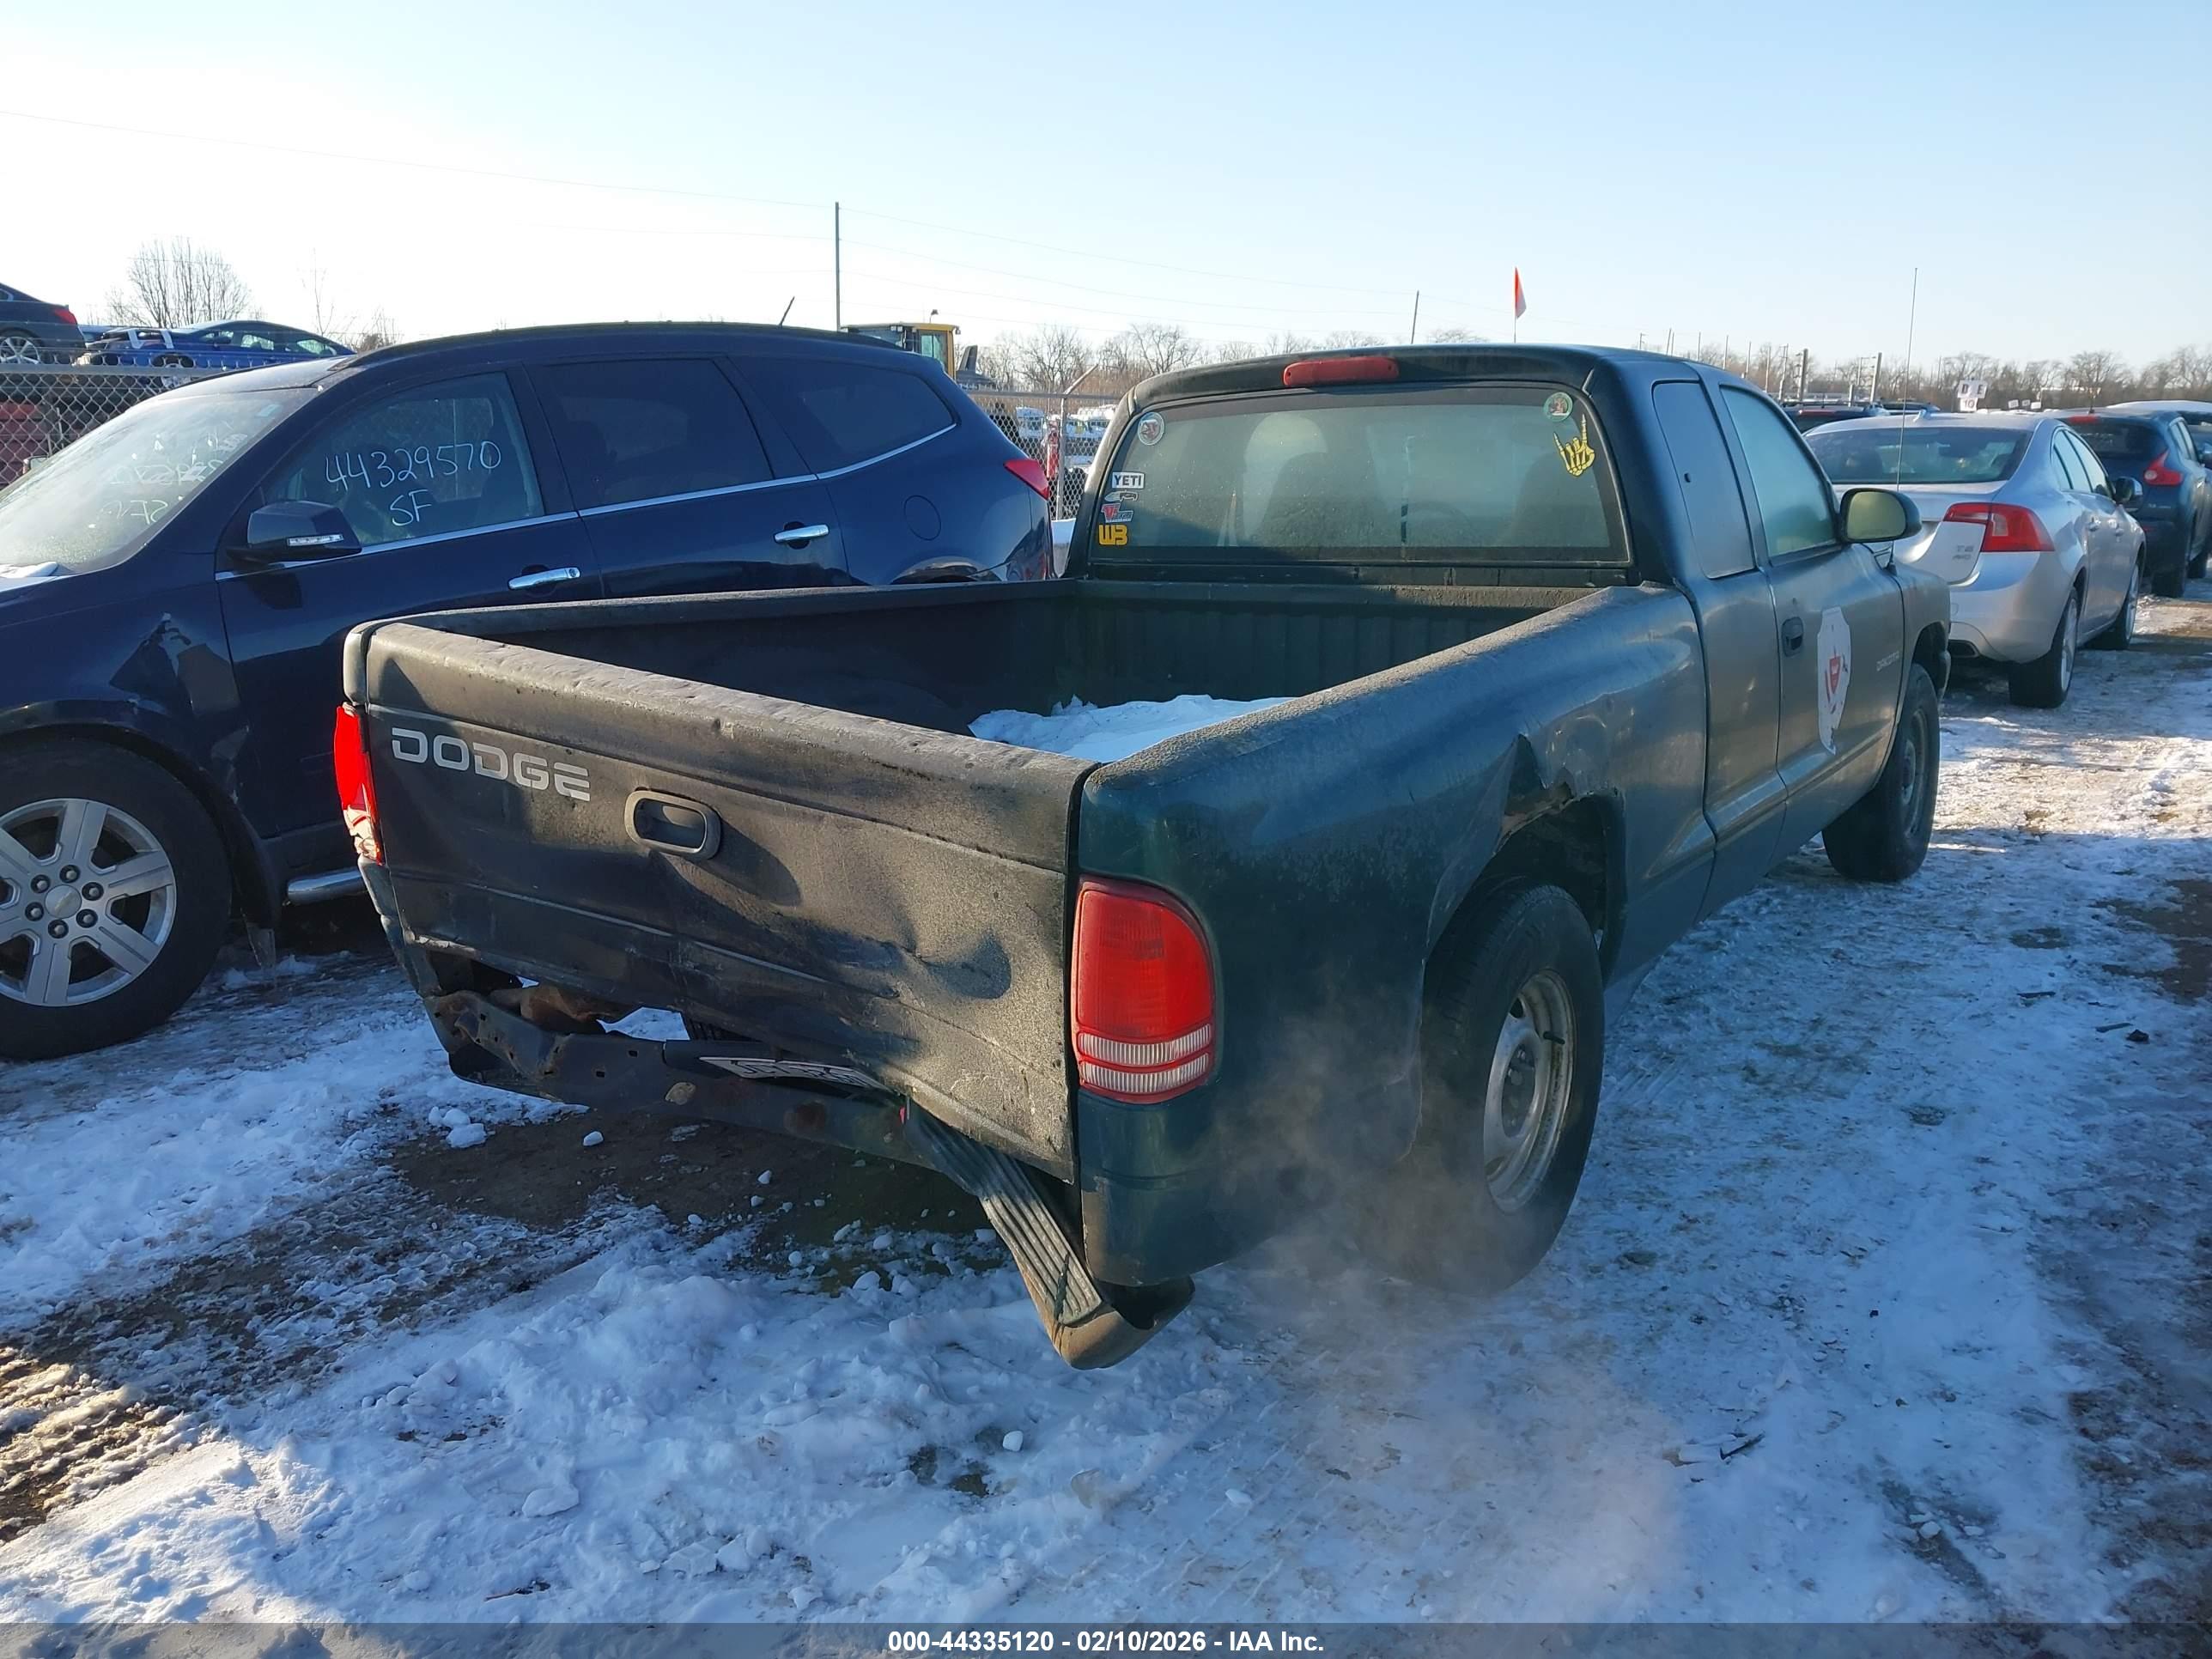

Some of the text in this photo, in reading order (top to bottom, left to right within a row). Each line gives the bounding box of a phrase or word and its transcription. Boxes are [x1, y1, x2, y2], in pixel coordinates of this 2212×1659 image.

[325, 441, 501, 491] 44329570
[1114, 475, 1142, 486] YETI
[390, 489, 432, 526] SF
[392, 727, 591, 801] DODGE
